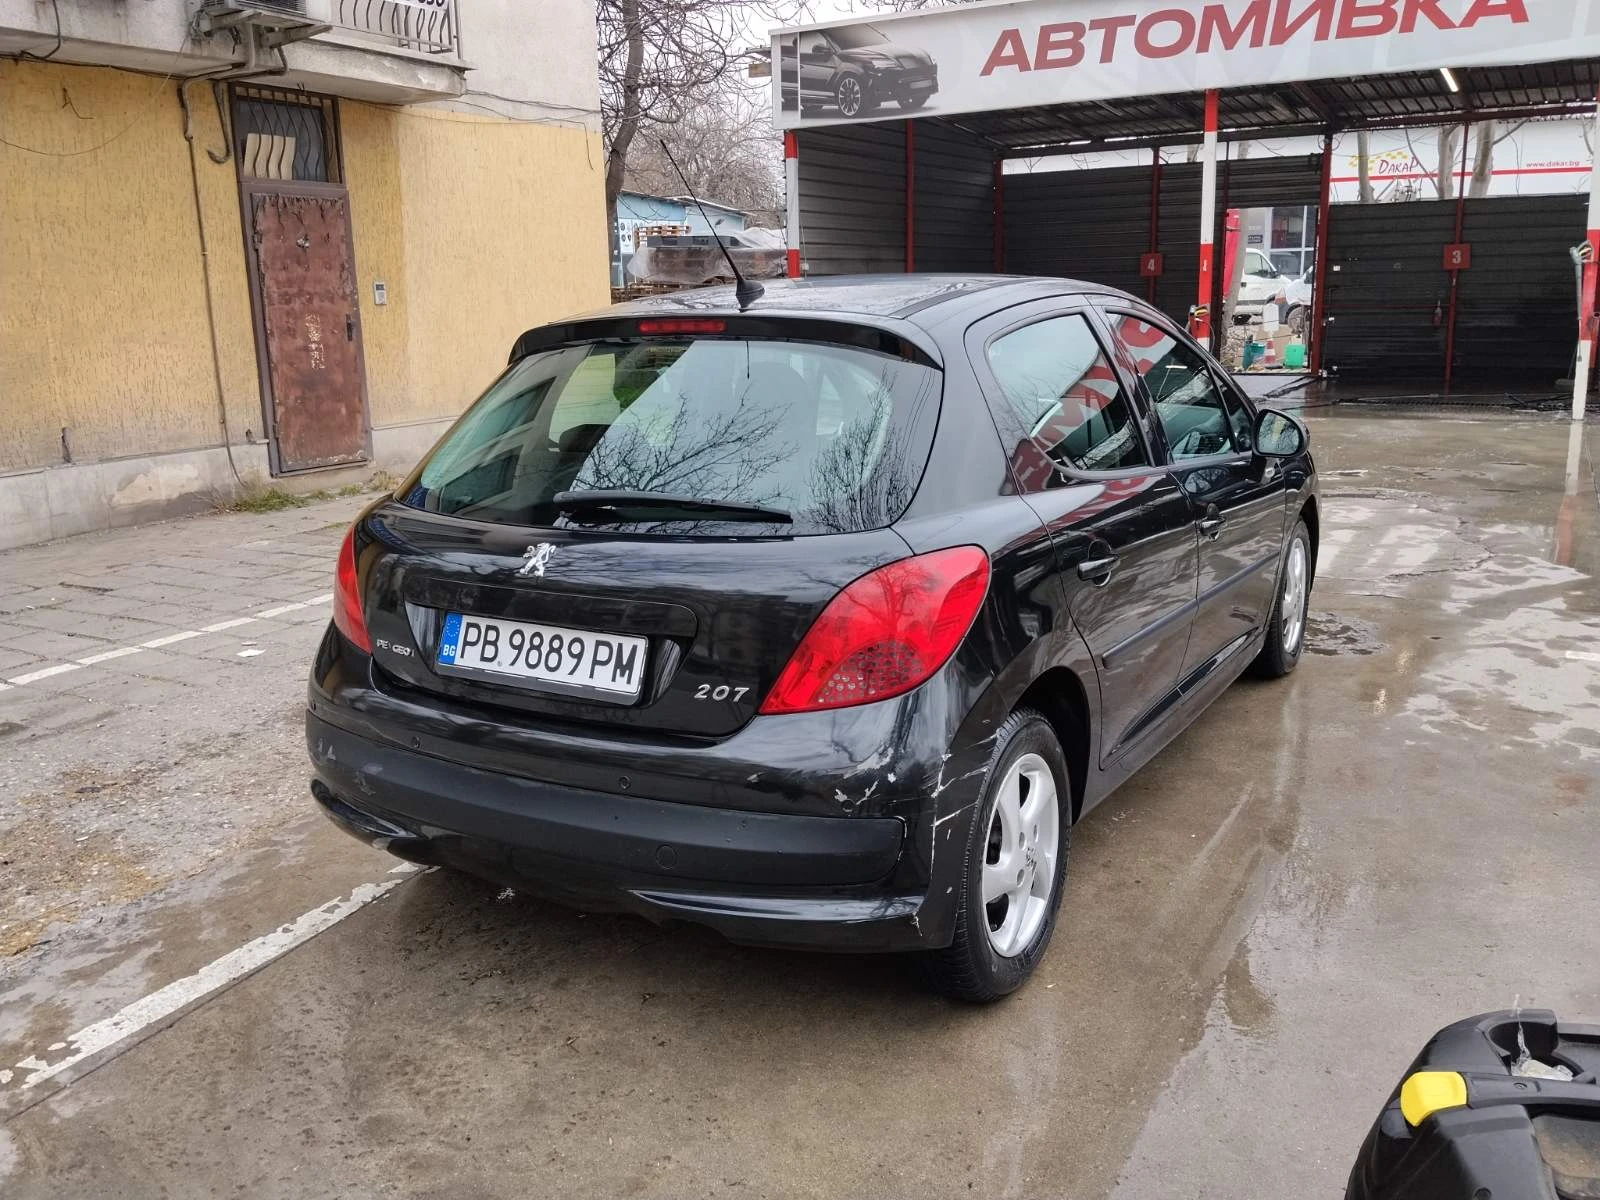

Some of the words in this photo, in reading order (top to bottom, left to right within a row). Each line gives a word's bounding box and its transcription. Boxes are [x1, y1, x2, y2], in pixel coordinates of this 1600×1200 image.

[979, 0, 1529, 76] АВТОМИВКА
[1526, 160, 1580, 168] www.dakar.bg
[1452, 250, 1461, 264] 3
[1147, 258, 1155, 272] 4
[442, 644, 456, 656] BG
[460, 621, 500, 662] PB
[508, 628, 585, 675] 9889
[588, 639, 638, 684] PM
[694, 683, 750, 702] 207
